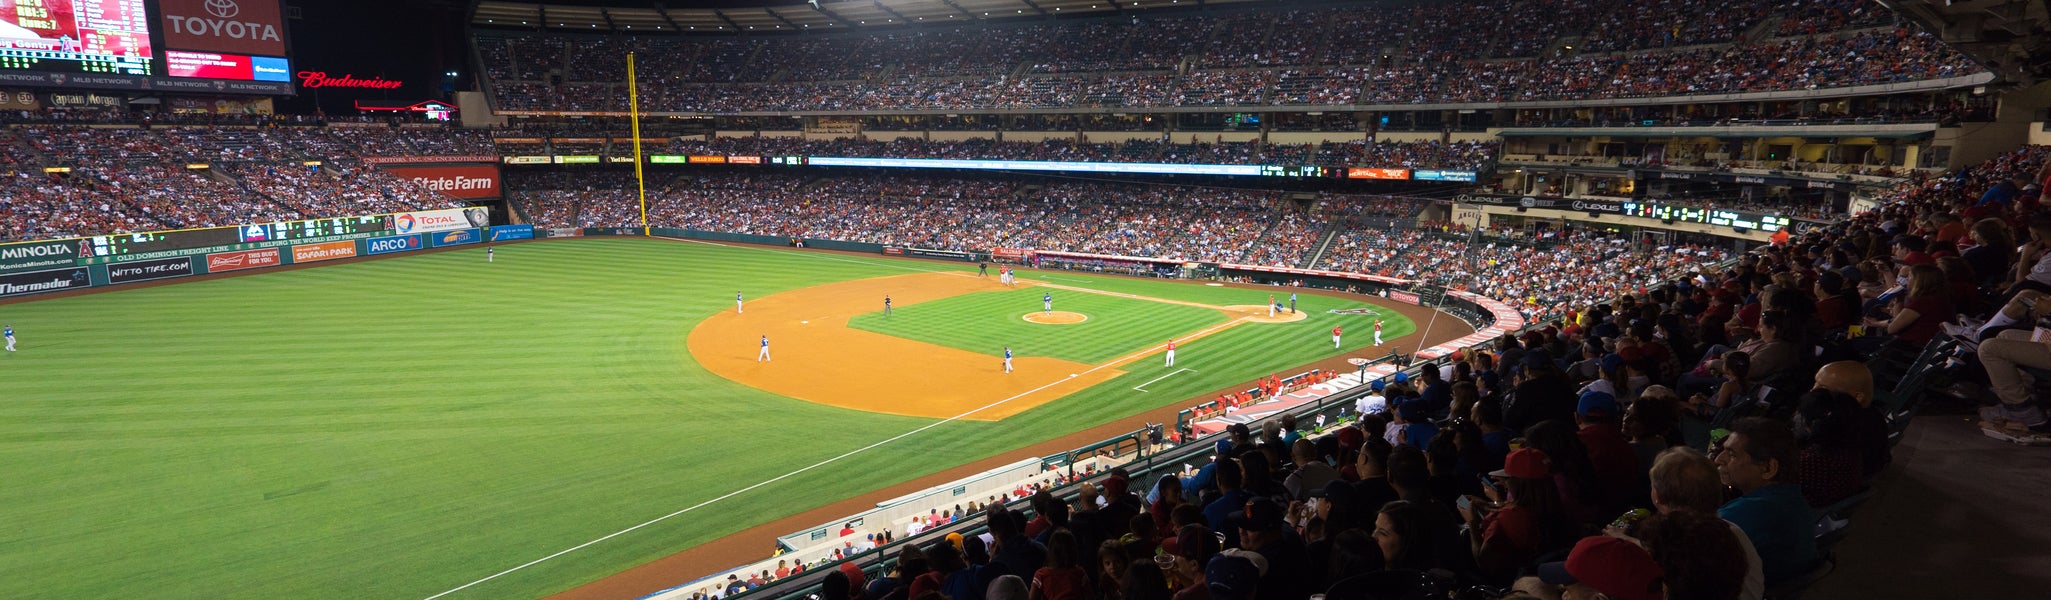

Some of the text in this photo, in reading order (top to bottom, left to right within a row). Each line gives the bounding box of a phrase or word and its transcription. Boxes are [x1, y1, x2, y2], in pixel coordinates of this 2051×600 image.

[166, 15, 281, 42] TOYOTA
[16, 40, 53, 51] Gentry
[0, 74, 45, 82] NETWORK
[297, 71, 403, 89] Budweiser
[50, 92, 121, 107] Captain Morgan
[1469, 196, 1503, 204] LEXUS
[1583, 203, 1620, 212] LEXUS
[419, 216, 456, 225] TOTAL
[260, 239, 288, 248] HELPING
[304, 236, 325, 244] WORLD
[326, 234, 341, 242] KEEP
[342, 232, 370, 241] PROMISES
[371, 238, 407, 252] ARCO
[1, 244, 72, 260] MINOLTA
[136, 249, 178, 260] DOMINION
[179, 246, 212, 256] FREIGHT
[296, 250, 328, 260] SAFARI
[330, 247, 353, 256] PARK
[0, 258, 73, 270] KonicaMinolta.com
[112, 261, 189, 279] NITTO TIRE.COM
[0, 278, 72, 294] Thermador
[1398, 293, 1420, 303] TOYOTA
